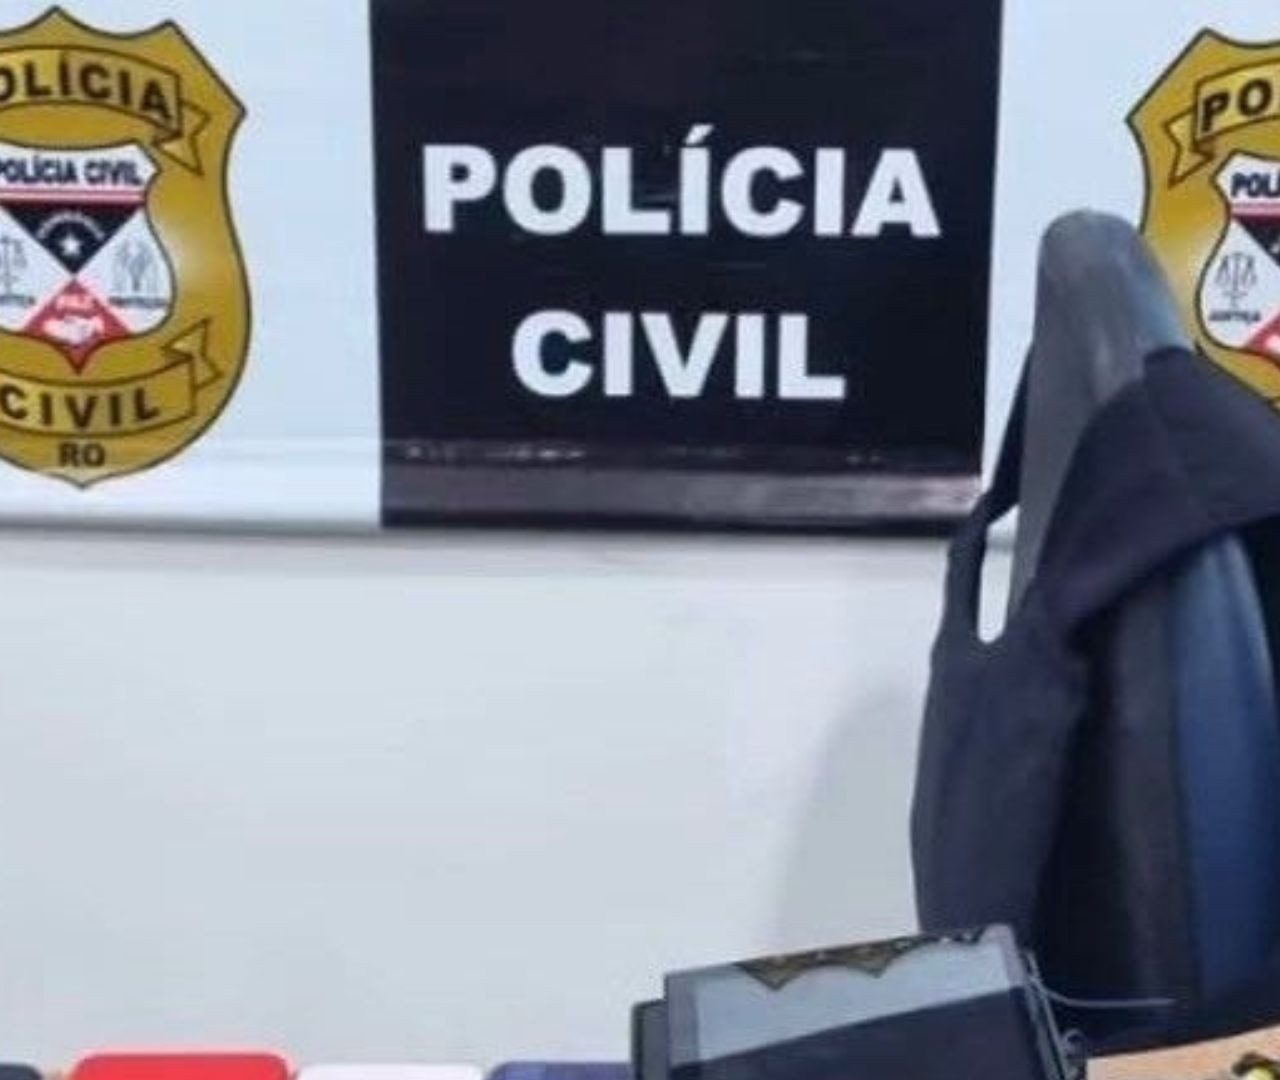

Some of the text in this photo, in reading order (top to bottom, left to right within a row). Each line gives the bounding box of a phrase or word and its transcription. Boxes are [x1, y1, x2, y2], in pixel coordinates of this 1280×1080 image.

[84, 161, 142, 184] CIVIL
[422, 124, 942, 238] POLÍCIA
[511, 310, 847, 400] CIVIL
[59, 442, 106, 468] RO
